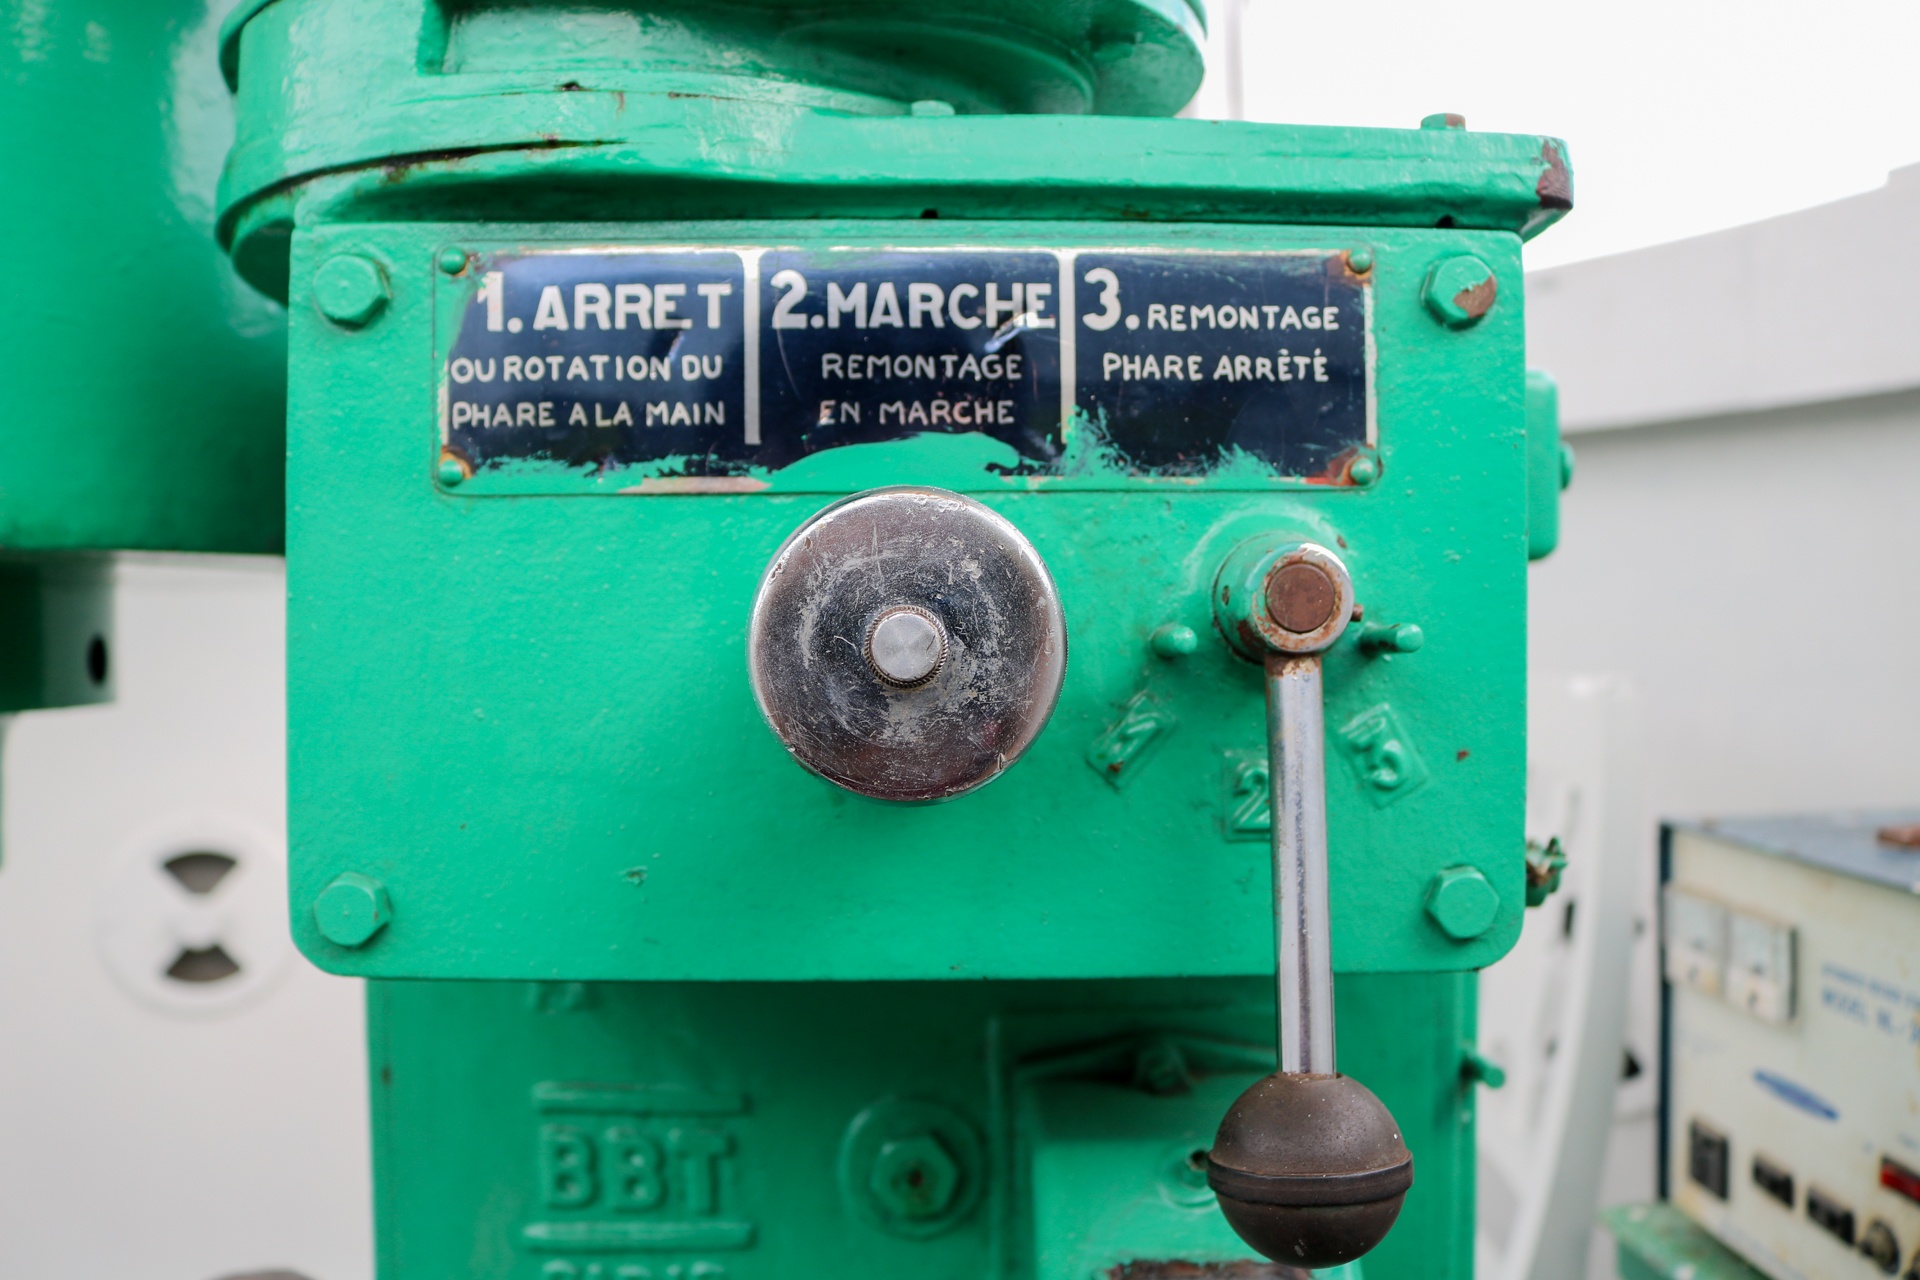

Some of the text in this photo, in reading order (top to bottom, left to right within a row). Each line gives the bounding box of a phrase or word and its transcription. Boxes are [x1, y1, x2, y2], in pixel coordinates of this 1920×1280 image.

[477, 271, 733, 334] 1. ARRET
[1082, 267, 1340, 332] 3. REMONTAGE
[450, 354, 723, 384] OU ROTATION DU
[821, 353, 1022, 382] REMONTAGE
[1102, 348, 1330, 383] PHARE ARRÊTÉ
[452, 400, 726, 430] PHARE A LA MAIN
[819, 400, 1016, 427] EN MARCHE
[540, 1123, 739, 1217] BBT
